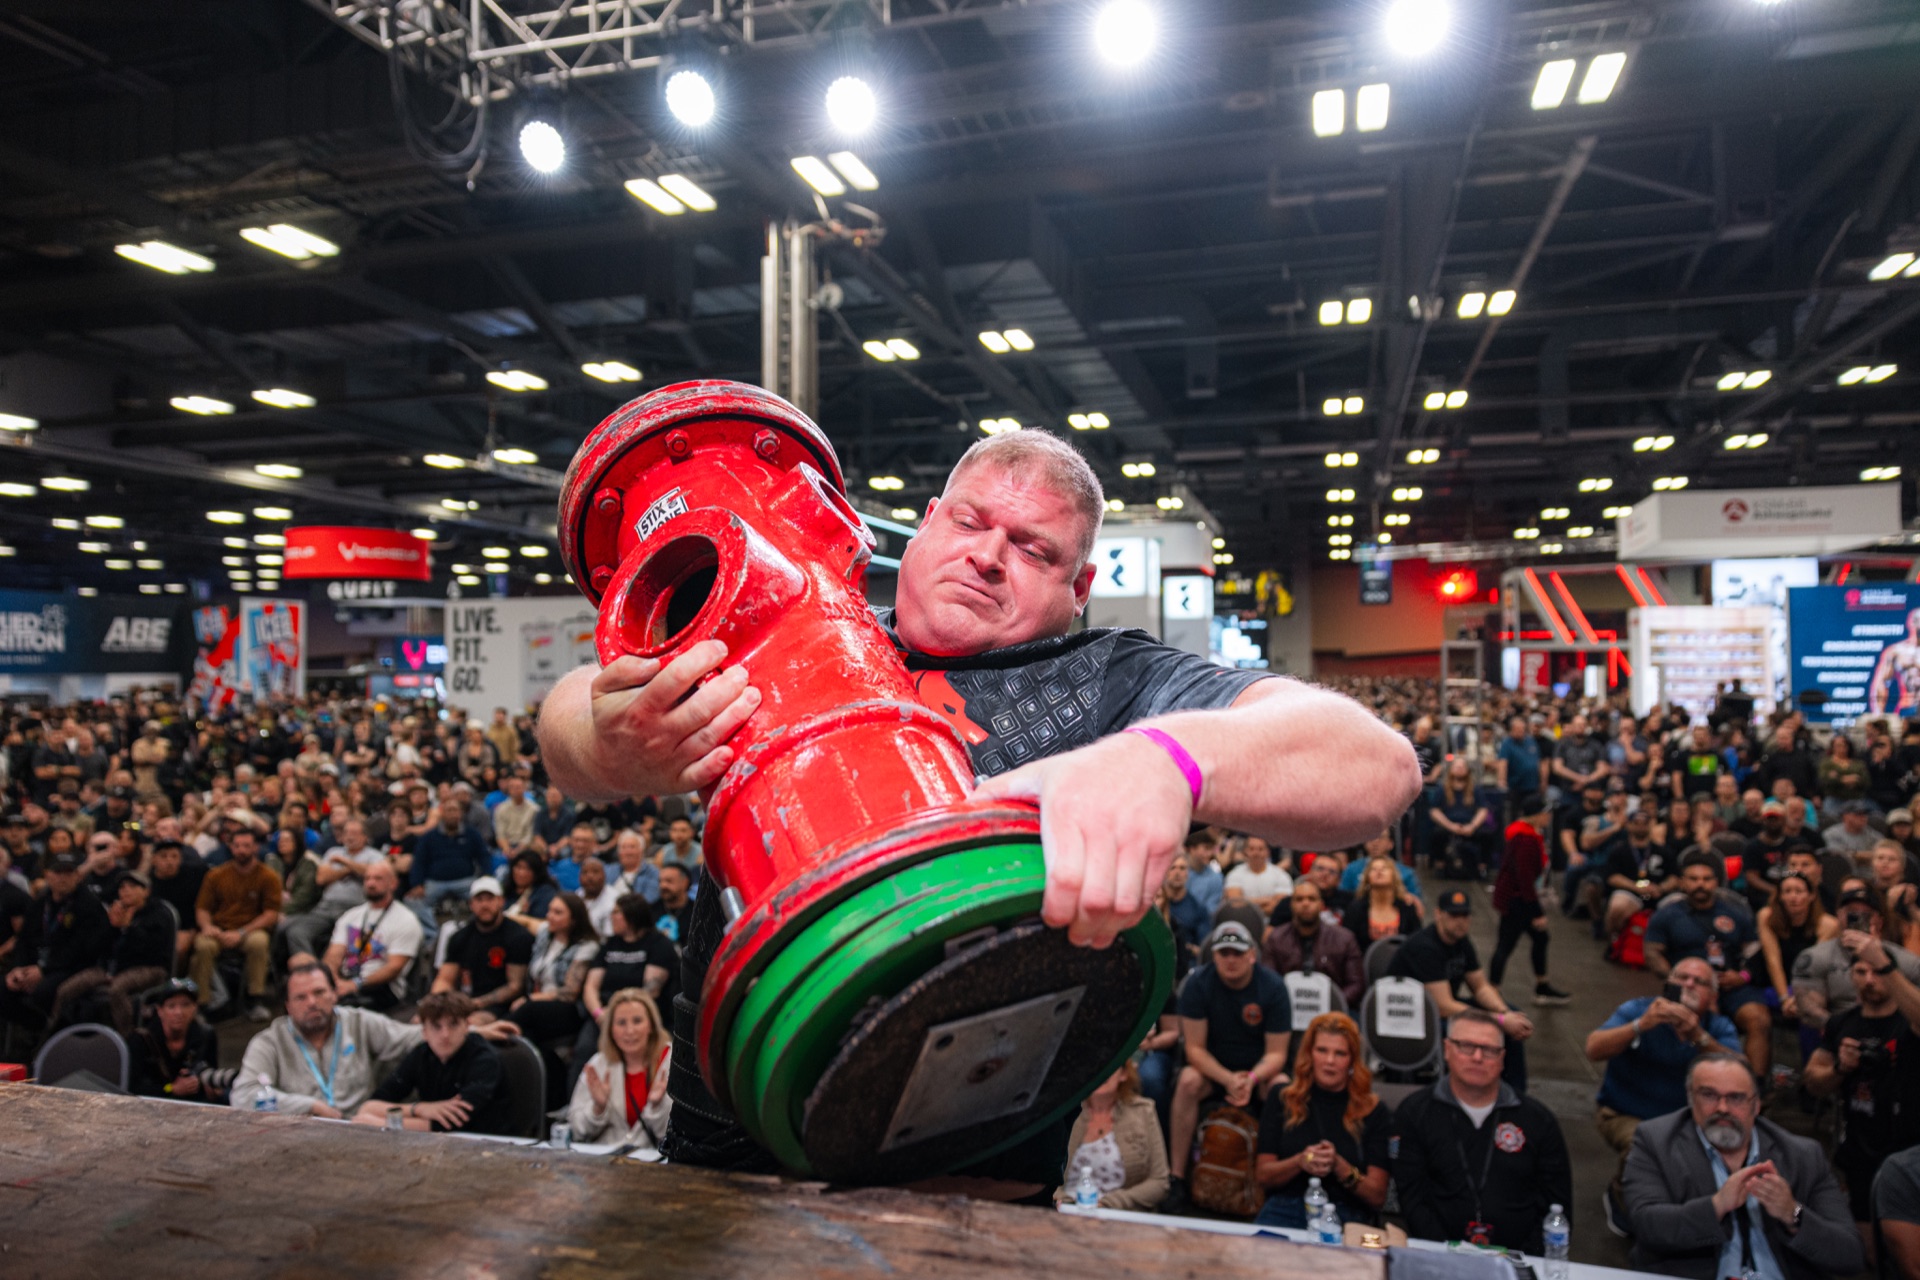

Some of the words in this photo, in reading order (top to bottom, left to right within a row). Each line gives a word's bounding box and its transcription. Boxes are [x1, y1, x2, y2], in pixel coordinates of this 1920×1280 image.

[641, 502, 666, 535] STIX
[103, 616, 171, 649] ABE
[452, 606, 502, 633] LIVE.
[452, 637, 488, 663] FIT.
